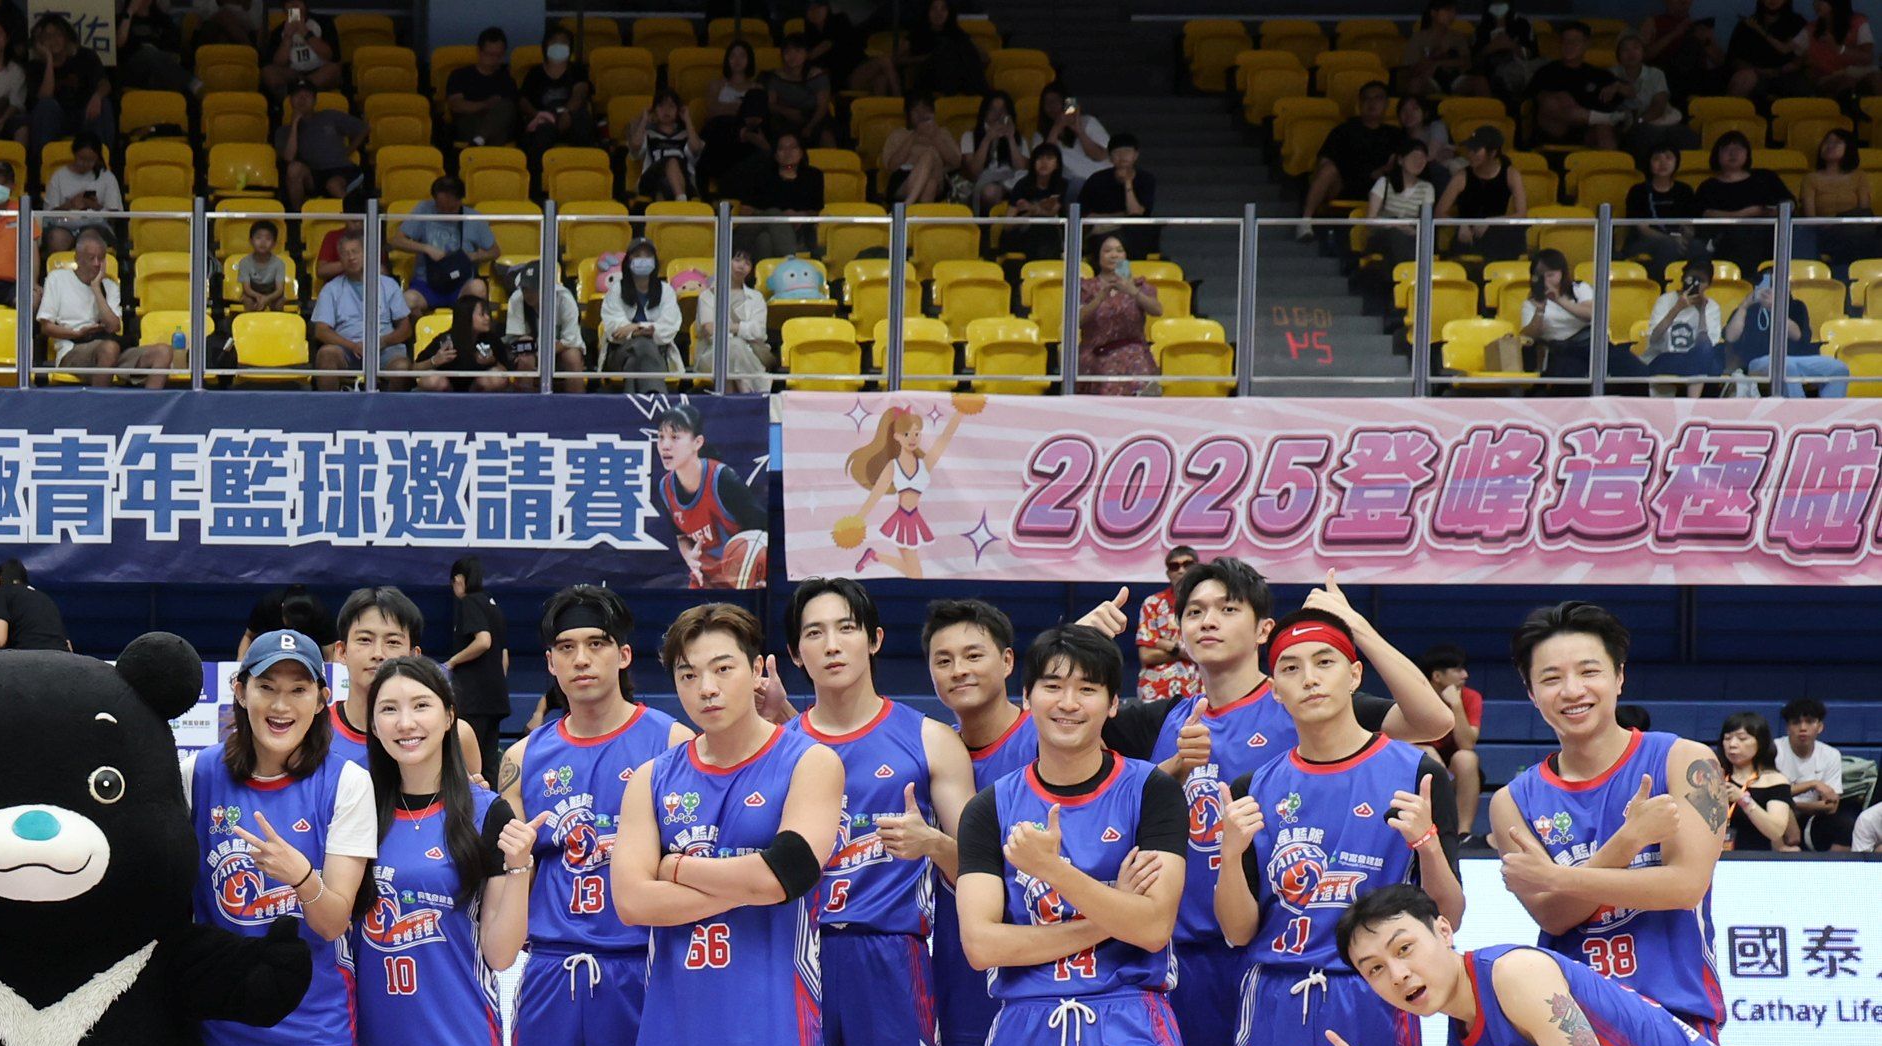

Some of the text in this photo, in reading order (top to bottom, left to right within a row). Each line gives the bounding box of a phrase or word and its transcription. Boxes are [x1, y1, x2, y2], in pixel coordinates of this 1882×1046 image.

[1010, 418, 1882, 560] 2025登峰造極啦
[281, 634, 296, 650] B
[1276, 827, 1325, 846] 星藍隊
[570, 875, 605, 914] 13
[684, 923, 731, 970] 66
[1054, 944, 1097, 982] 14
[1582, 933, 1637, 979] 38
[1727, 925, 1882, 978] 國泰
[384, 956, 417, 995] 10
[1731, 997, 1828, 1029] Cathay
[1837, 997, 1882, 1022] Life
